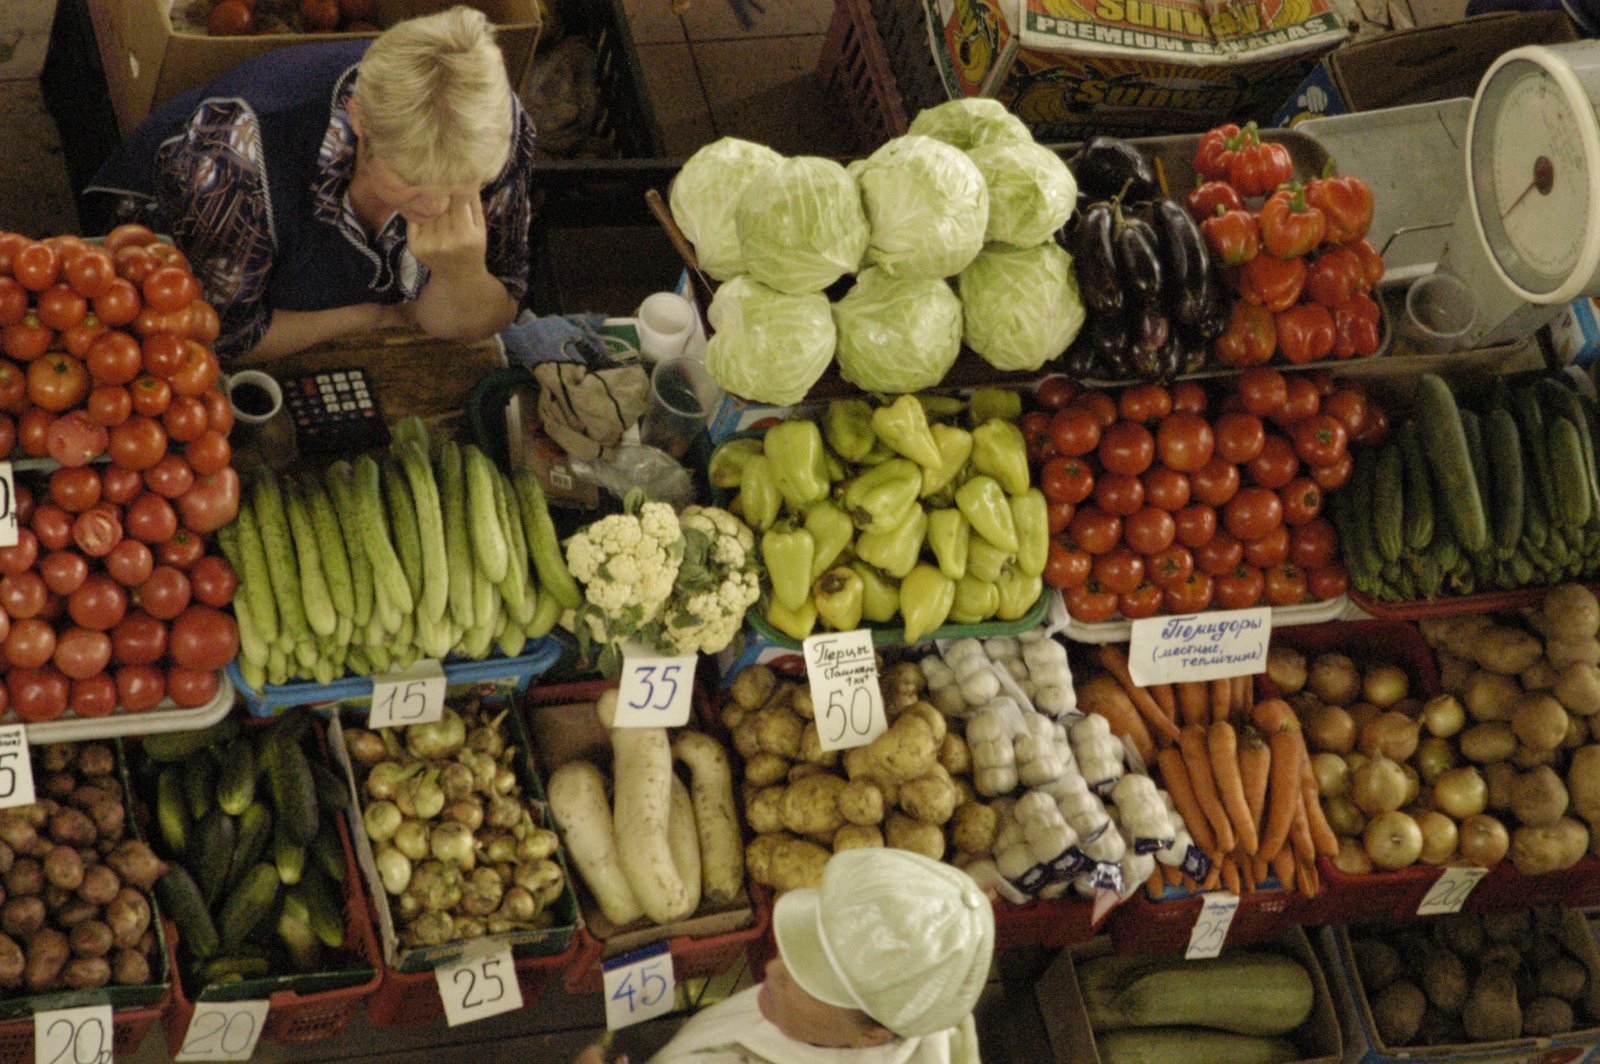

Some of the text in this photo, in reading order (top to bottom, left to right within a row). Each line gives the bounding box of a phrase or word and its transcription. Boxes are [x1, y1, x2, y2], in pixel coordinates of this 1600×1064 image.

[1036, 15, 1328, 54] PREMIUM BANANAS
[1162, 616, 1263, 642] Помидоры
[813, 639, 870, 669] Перцы
[378, 681, 427, 721] 15
[628, 665, 682, 710] 35
[826, 687, 872, 742] 50
[1187, 919, 1229, 954] 25
[452, 960, 505, 1010] 25
[611, 962, 668, 1013] 45
[182, 1011, 255, 1054] 20
